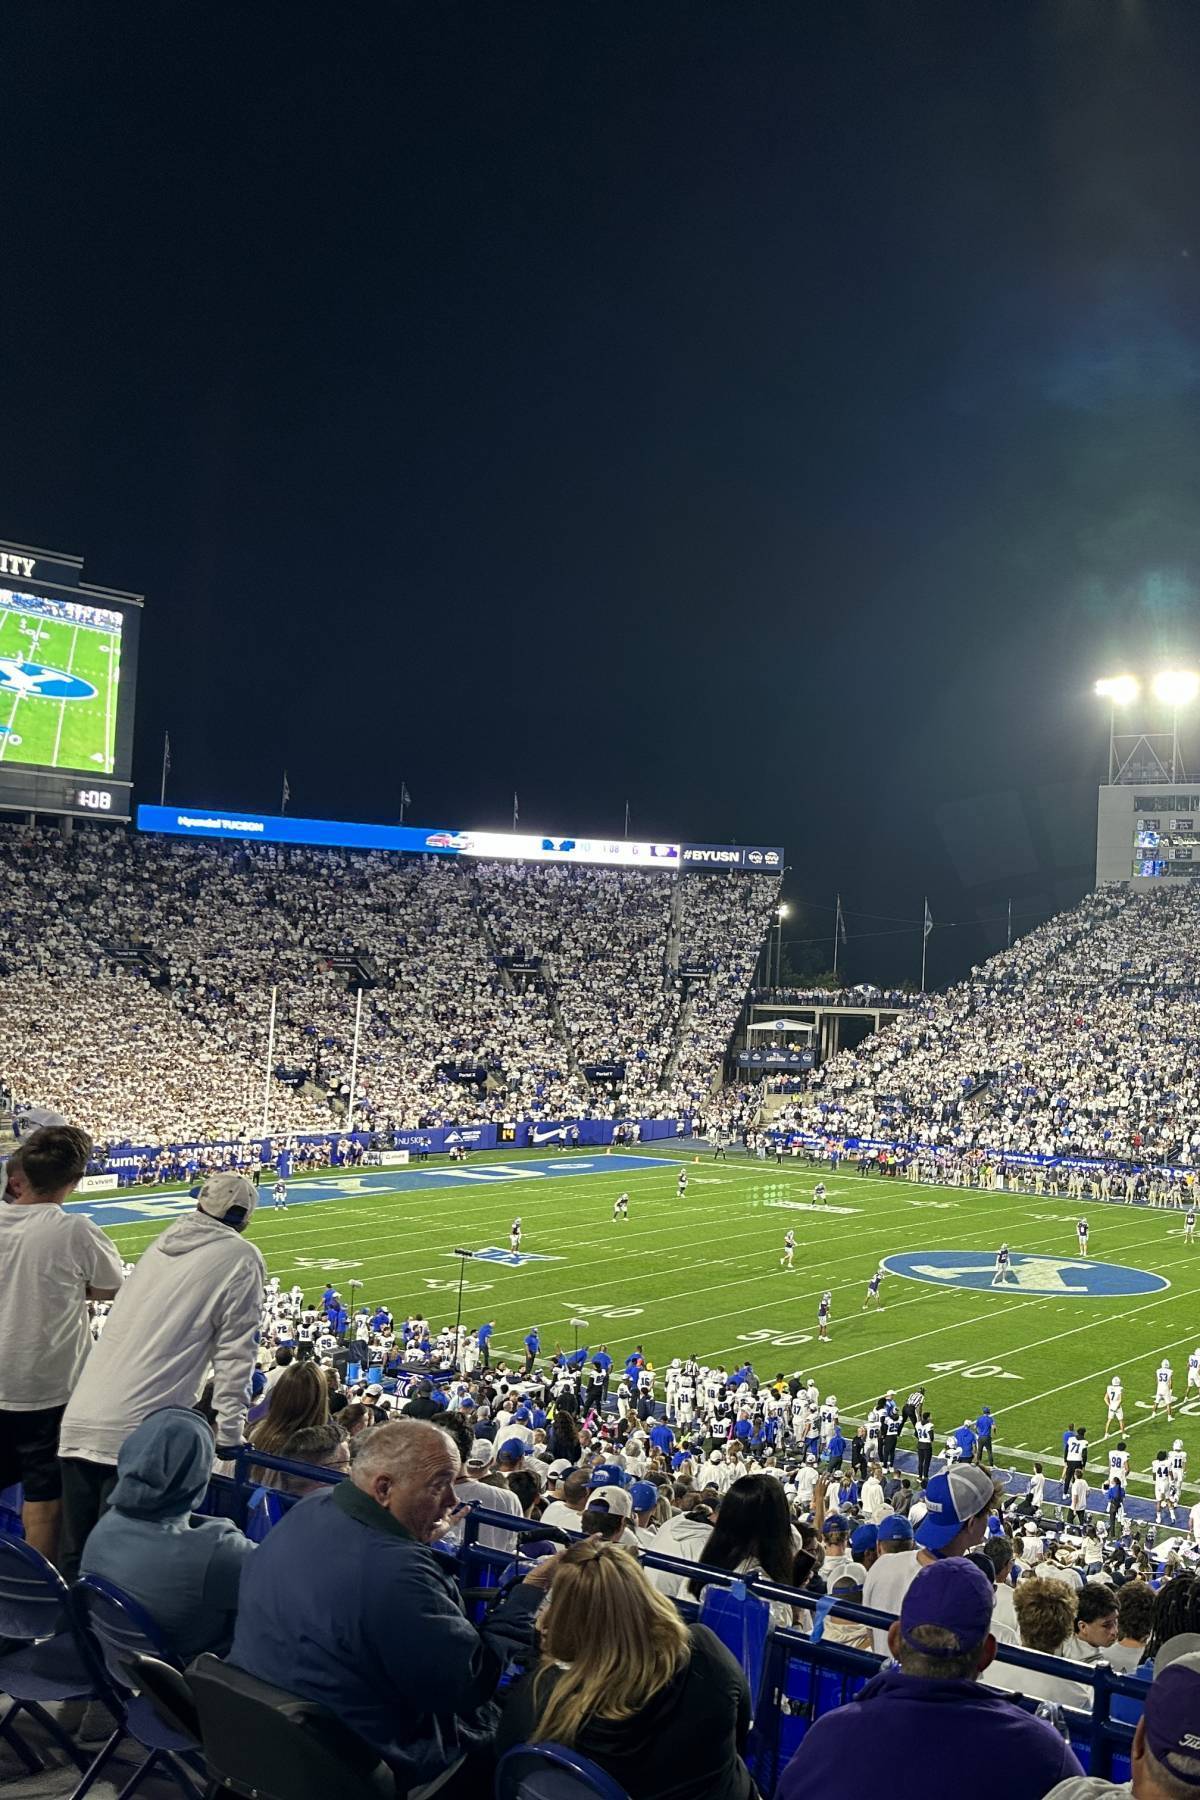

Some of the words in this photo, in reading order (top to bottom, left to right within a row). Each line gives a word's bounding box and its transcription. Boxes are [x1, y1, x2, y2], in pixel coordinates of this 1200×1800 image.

[683, 850, 740, 862] #BYUSN
[300, 1330, 309, 1339] 91
[736, 1328, 814, 1347] 50
[1189, 1358, 1199, 1368] 30
[925, 1360, 1004, 1379] 40
[640, 1377, 650, 1387] 16
[1158, 1372, 1169, 1383] 53
[681, 1394, 690, 1403] 31
[1110, 1391, 1116, 1401] 7
[822, 1412, 832, 1423] 54
[713, 1423, 724, 1434] 50
[1070, 1442, 1081, 1454] 71
[1173, 1458, 1182, 1469] 11
[1157, 1466, 1169, 1478] 44
